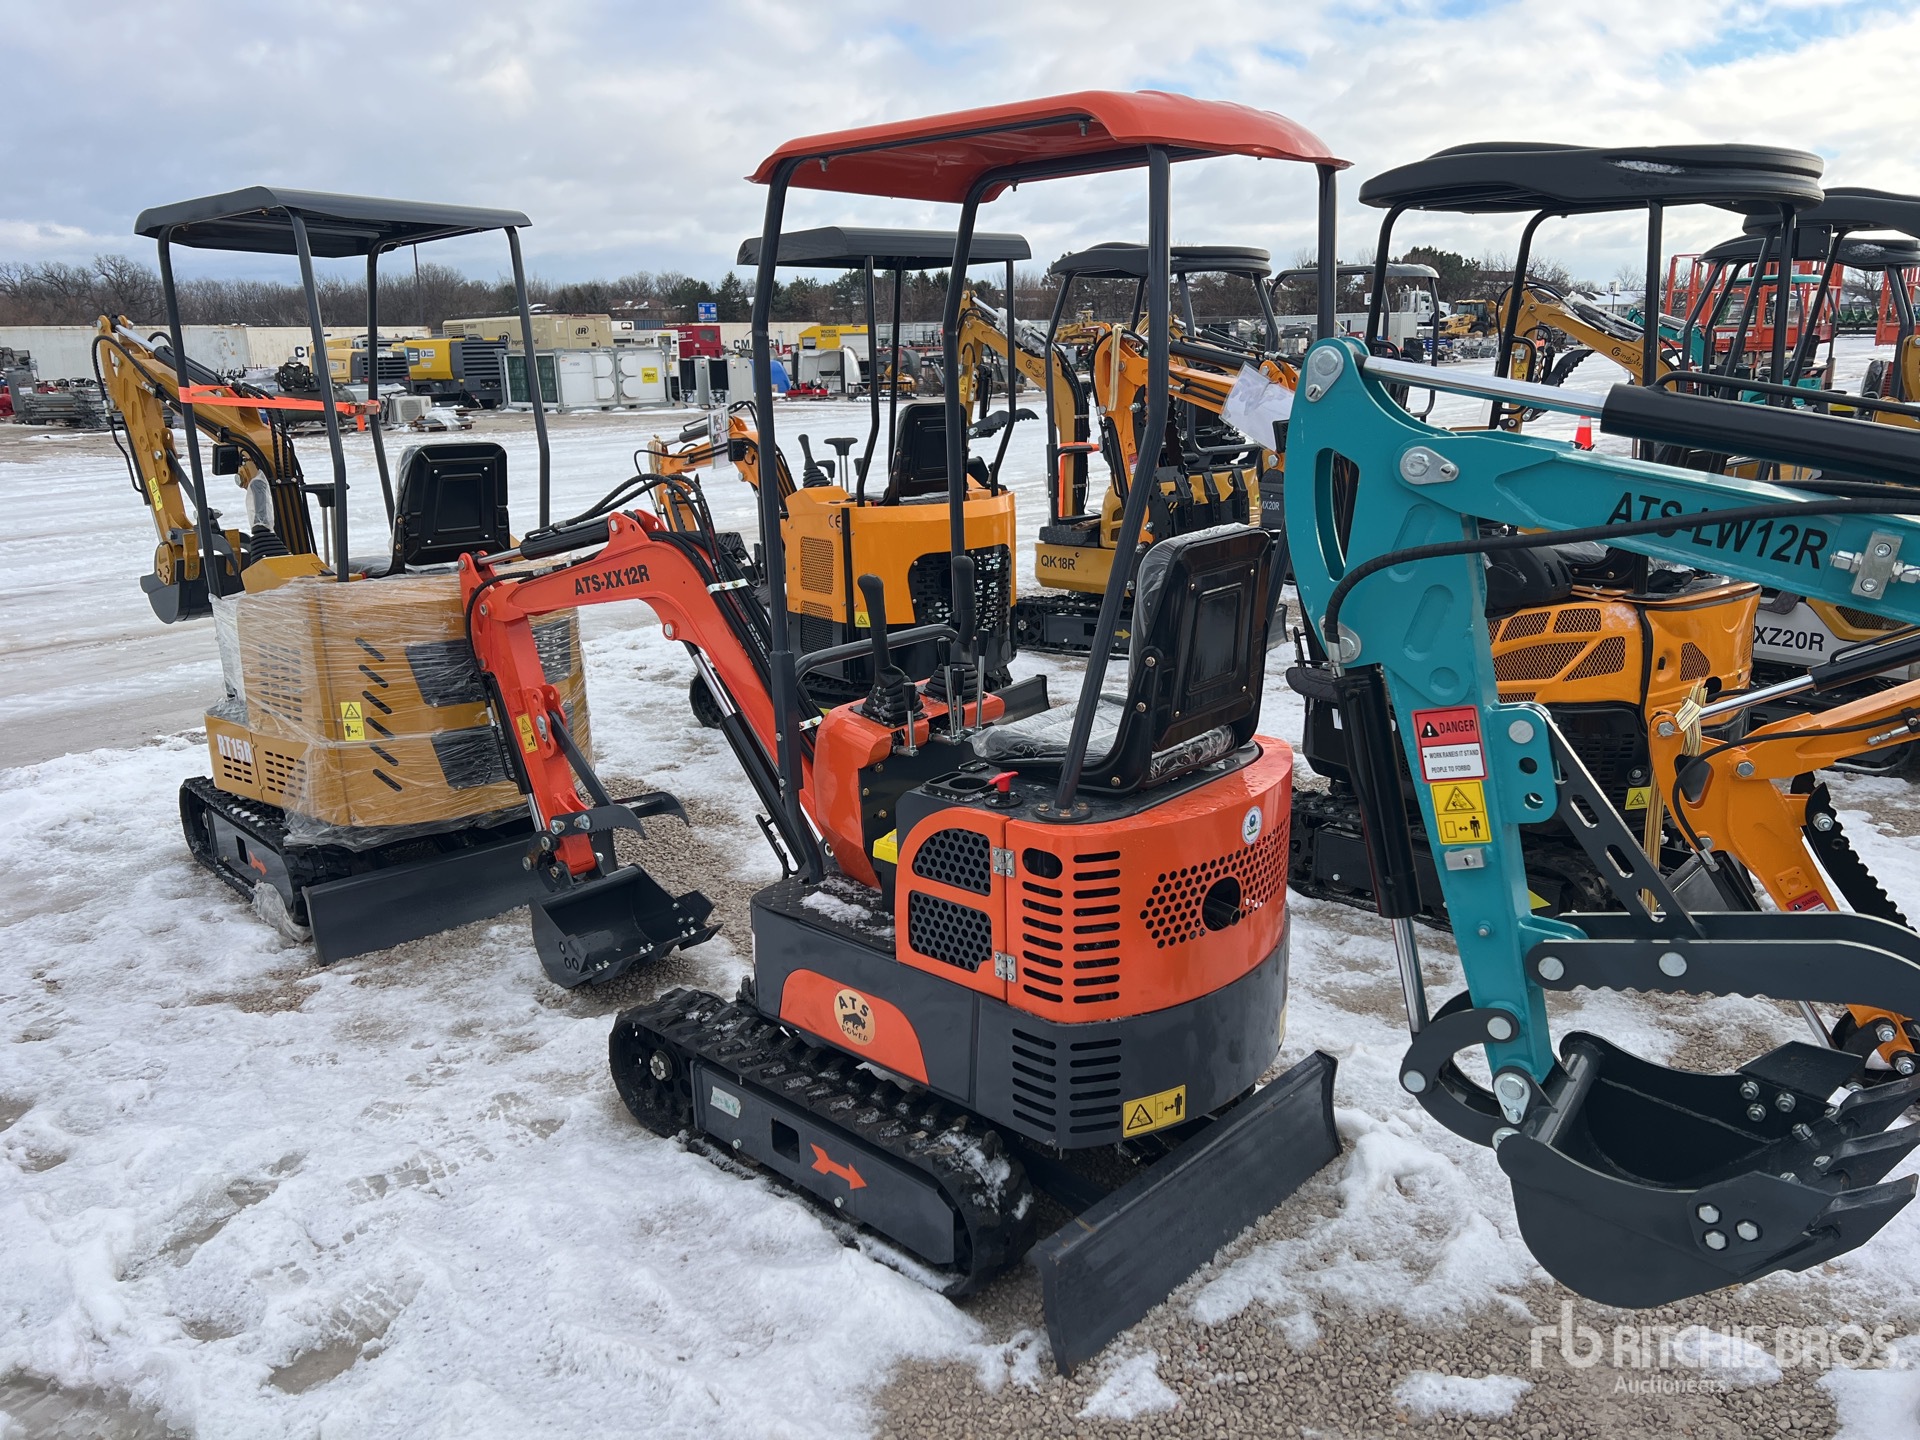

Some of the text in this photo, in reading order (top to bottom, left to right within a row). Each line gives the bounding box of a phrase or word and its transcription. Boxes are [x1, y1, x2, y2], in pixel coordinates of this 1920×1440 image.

[733, 340, 752, 350] CM
[1605, 491, 1829, 570] ATS-LW12R
[1041, 554, 1076, 571] QK18R
[575, 564, 650, 595] ATS-XX12R
[1754, 625, 1825, 652] XZ20R
[1439, 719, 1476, 734] DANGER
[216, 733, 253, 764] RT15R
[1463, 749, 1479, 757] STAND
[838, 995, 869, 1018] ATS
